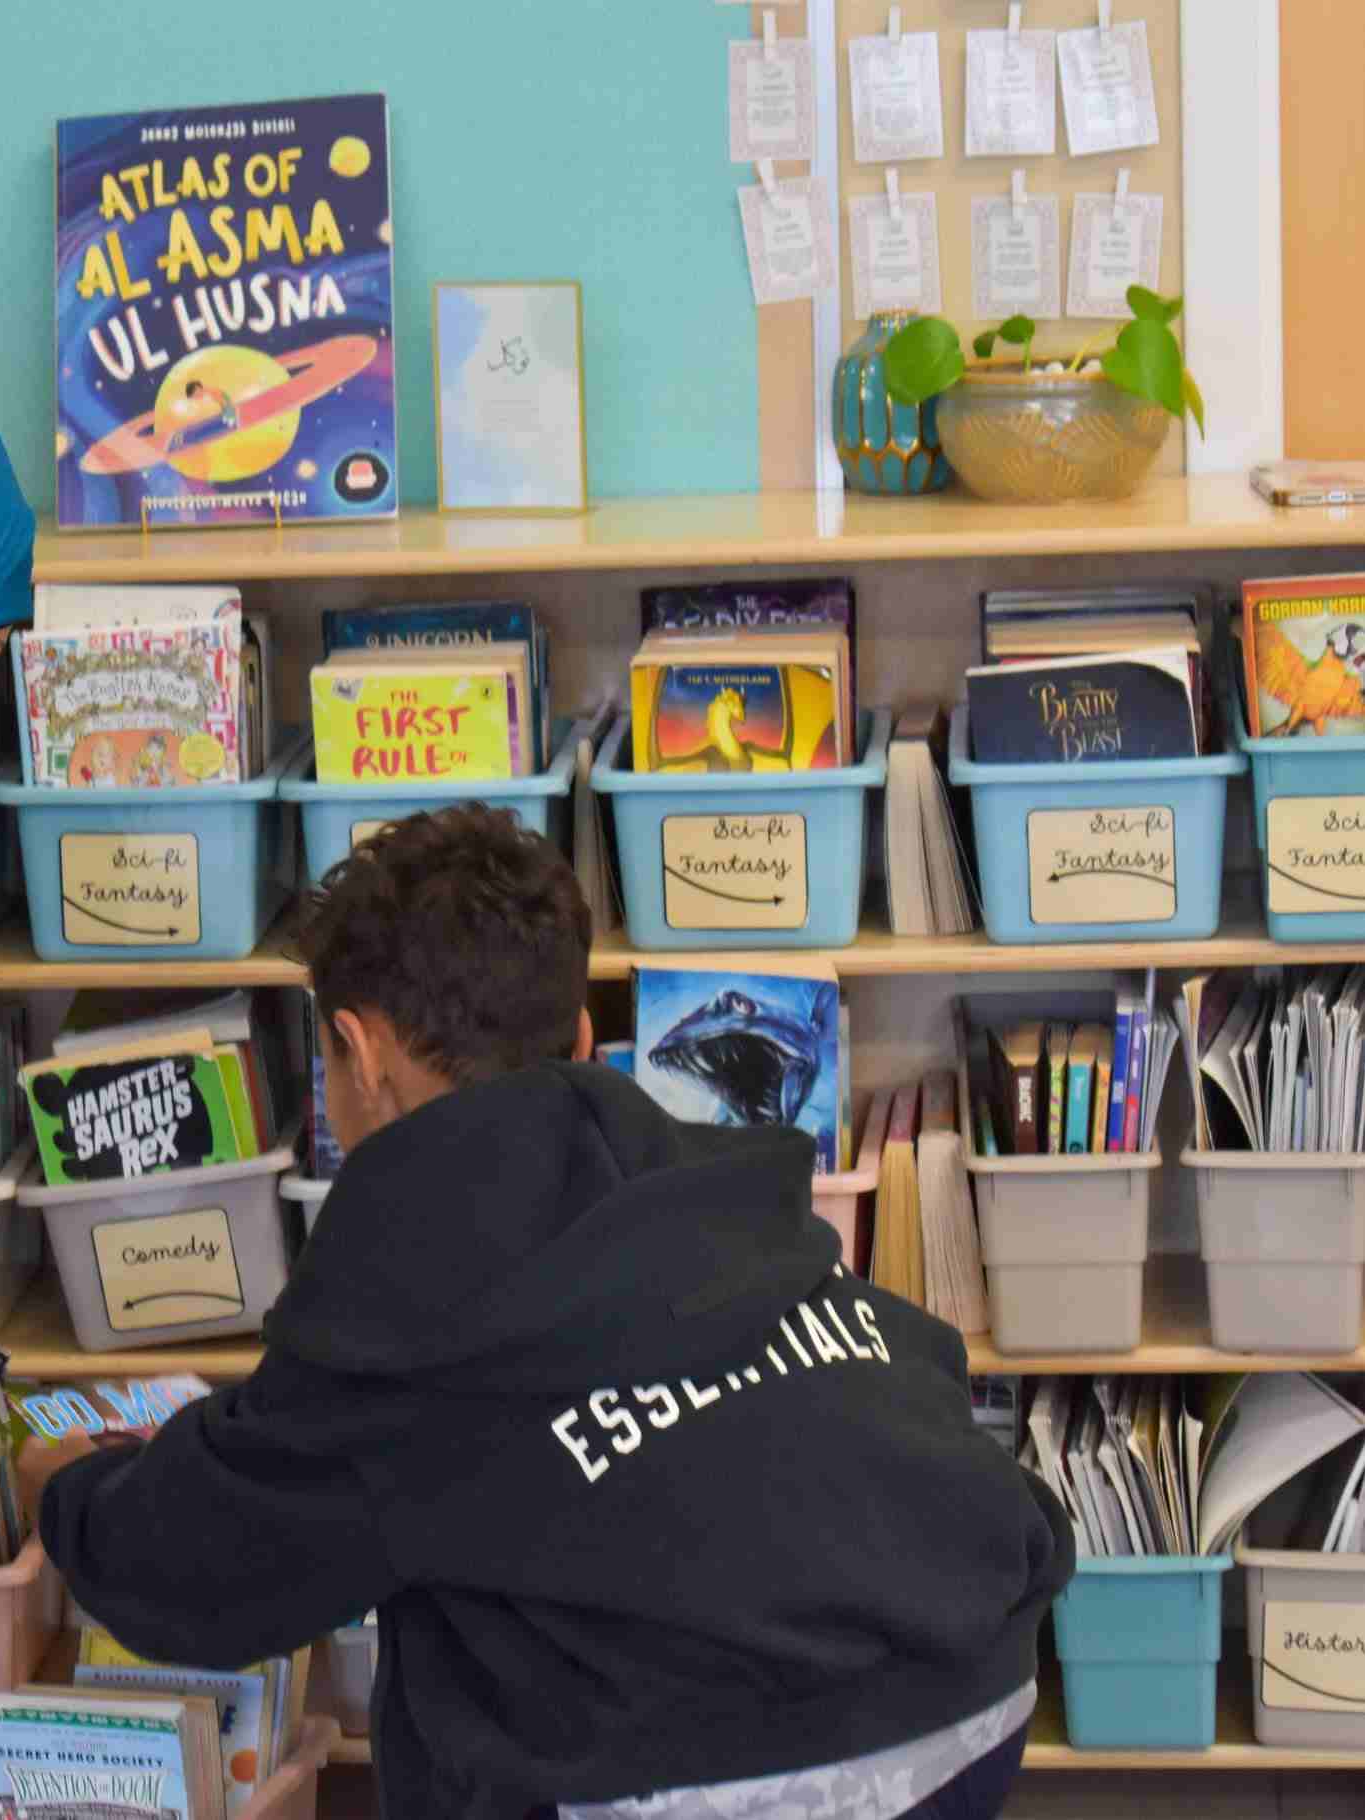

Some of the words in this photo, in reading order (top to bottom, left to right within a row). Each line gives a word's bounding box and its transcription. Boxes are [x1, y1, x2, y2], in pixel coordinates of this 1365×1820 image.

[99, 152, 231, 221] ATLAS
[244, 148, 302, 197] OF
[76, 230, 151, 301] AL
[157, 199, 344, 284] ASMA
[89, 308, 169, 381] UL
[172, 272, 346, 349] HUSNA
[1259, 599, 1323, 621] GORDON
[356, 705, 471, 739] FIRST
[353, 744, 450, 778] RULE
[679, 854, 791, 880] Fantasy
[1054, 846, 1170, 873] Fantasy
[80, 881, 189, 909] Fantasy
[75, 1080, 193, 1160] SAURUS
[121, 1235, 221, 1266] Comedy
[57, 1750, 95, 1765] HERO
[102, 1754, 164, 1768] SOCIETY
[110, 1774, 161, 1803] DOOM
